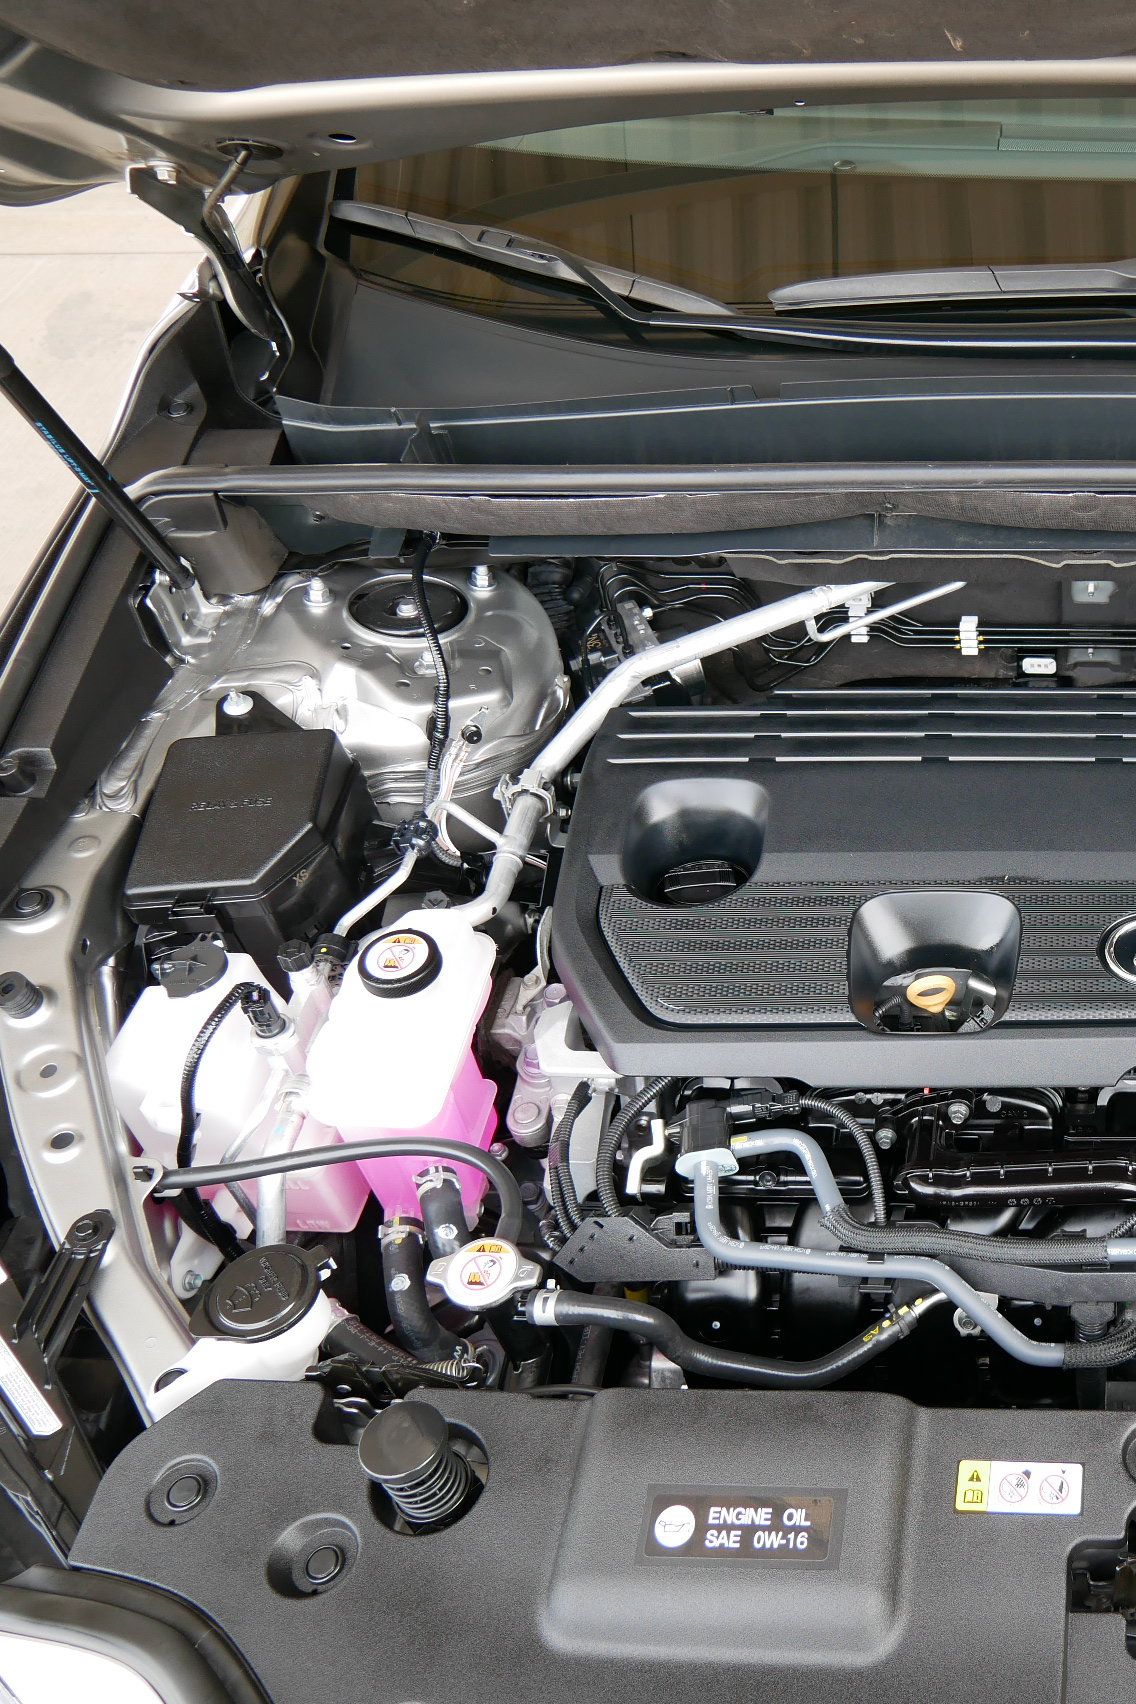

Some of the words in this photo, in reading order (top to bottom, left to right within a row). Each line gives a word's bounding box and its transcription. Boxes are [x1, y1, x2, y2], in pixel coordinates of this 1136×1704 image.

[35, 421, 65, 453] STABILUS
[707, 1506, 773, 1526] ENGINE
[782, 1508, 811, 1527] OIL
[705, 1530, 742, 1549] SAE
[753, 1531, 809, 1550] 0W-16
